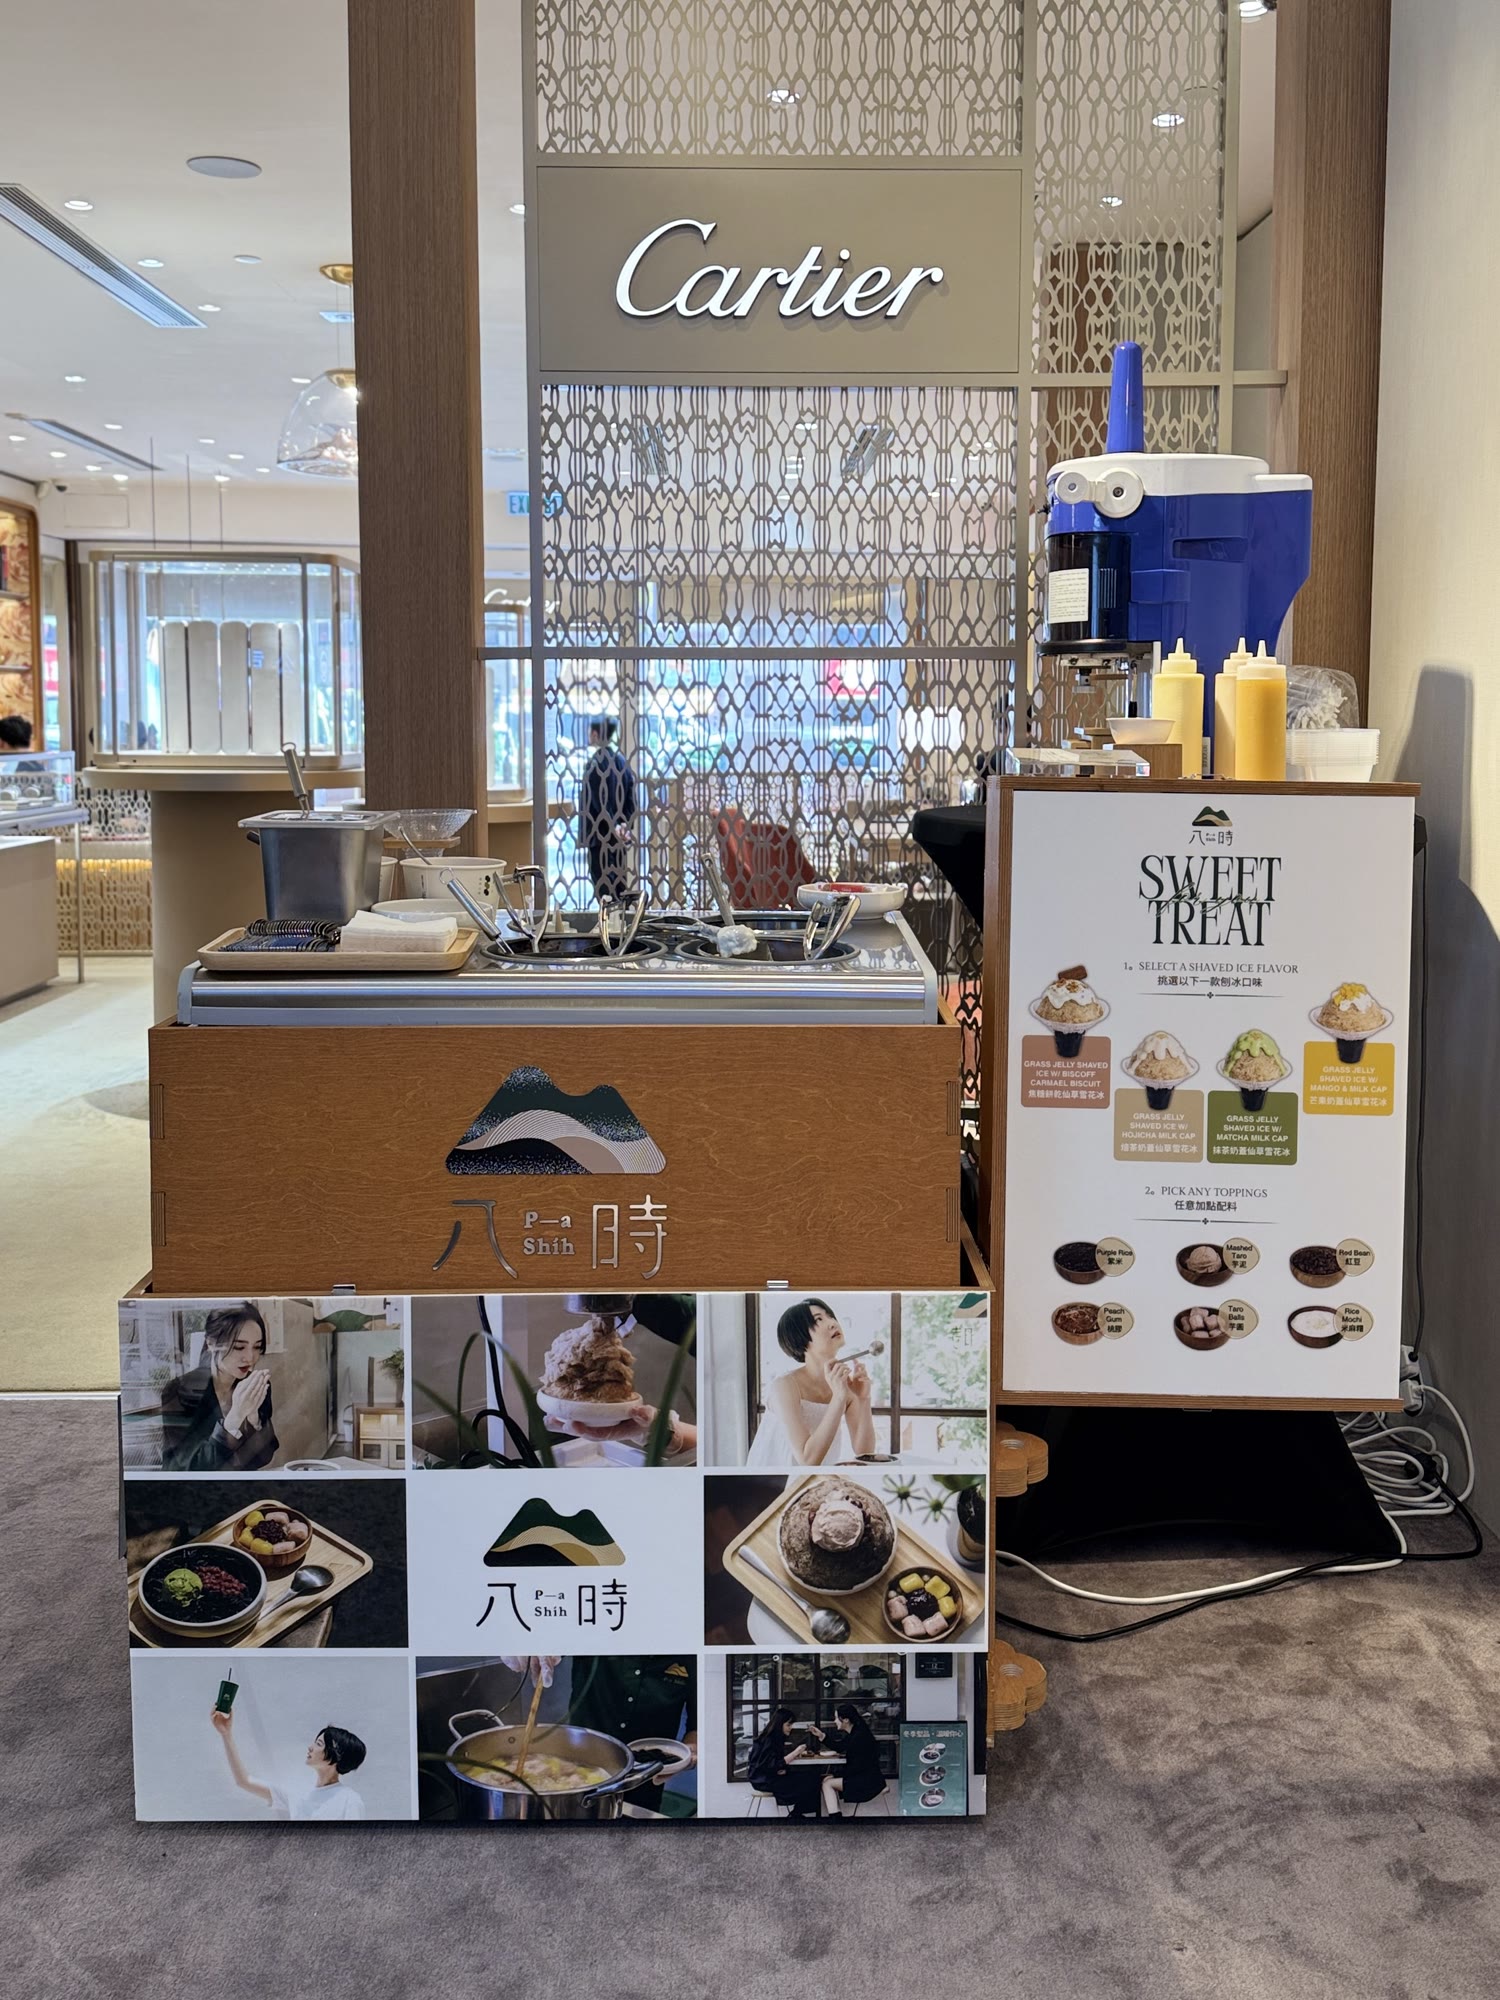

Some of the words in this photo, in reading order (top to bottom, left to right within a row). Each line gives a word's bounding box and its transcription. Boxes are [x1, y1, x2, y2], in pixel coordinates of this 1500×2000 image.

[615, 218, 945, 318] Cartier
[1188, 830, 1206, 846] 八
[1217, 830, 1233, 847] 時
[1139, 854, 1282, 902] SWEET
[1147, 899, 1271, 946] TREAT
[1139, 961, 1177, 971] SELECT
[1179, 962, 1187, 972] A
[1189, 962, 1234, 973] SHAVED
[1236, 963, 1254, 973] ICE
[1257, 963, 1298, 974] FLAVOR
[1062, 1070, 1096, 1078] BISCOFF
[1310, 1084, 1340, 1092] MANGO
[1350, 1085, 1369, 1093] MILK
[1226, 1115, 1254, 1123] GRASS
[1130, 1122, 1161, 1130] SHAVED
[1121, 1131, 1157, 1139] HOJICHA
[1161, 1186, 1186, 1196] PICK
[1188, 1187, 1211, 1196] ANY
[1214, 1187, 1268, 1198] TOPPINGS
[1174, 1200, 1237, 1212] 任意加點配料
[432, 1200, 518, 1279] 八
[592, 1194, 668, 1279] 時
[1353, 1249, 1370, 1257] Bean
[1345, 1258, 1361, 1266] 紅豆
[1103, 1307, 1125, 1315] Peach
[476, 1583, 532, 1632] 八
[578, 1578, 628, 1631] 時
